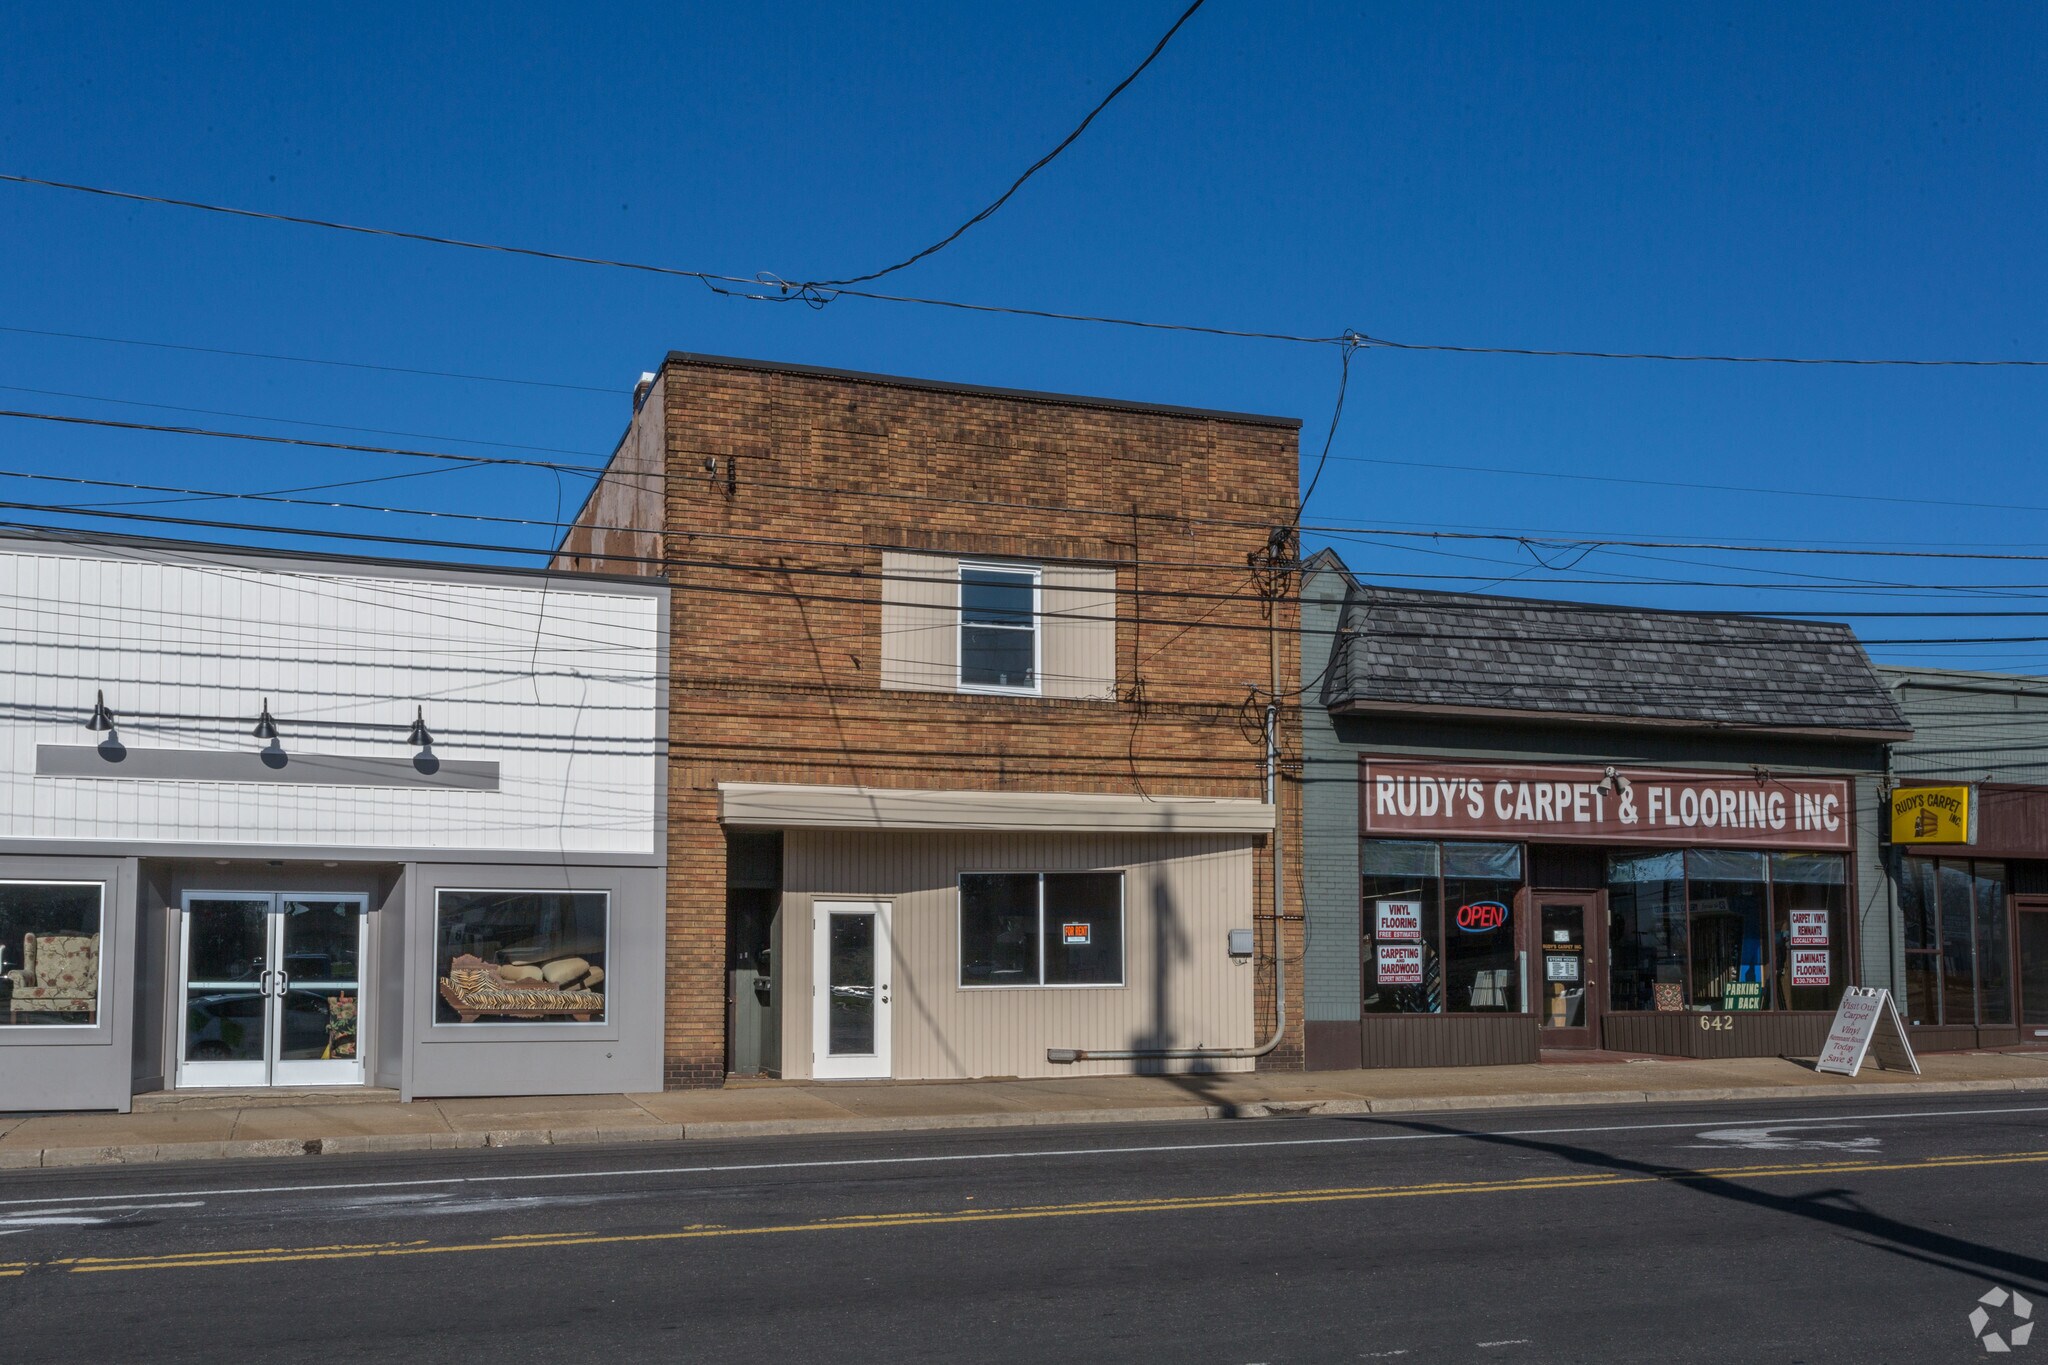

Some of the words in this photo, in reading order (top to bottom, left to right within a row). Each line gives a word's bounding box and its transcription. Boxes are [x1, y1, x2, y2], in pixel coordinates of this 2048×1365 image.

[1376, 774, 1485, 819] RUDY'S
[1494, 780, 1609, 823] CARPET
[1618, 784, 1638, 825] &
[1648, 786, 1786, 830] FLOORING
[1795, 792, 1840, 832] INC
[1895, 794, 1924, 815] RUDY'S
[1927, 794, 1961, 813] CARPET
[1389, 904, 1411, 916] VINYL
[1457, 905, 1504, 927] OPEN
[1792, 913, 1811, 924] CARPET
[1814, 913, 1827, 924] VINYL
[1381, 917, 1418, 929] FLOORING
[1065, 926, 1075, 937] FOR
[1075, 926, 1088, 937] RENT
[1798, 926, 1822, 936] REMNANTS
[1380, 948, 1419, 959] CARPETING
[1796, 953, 1826, 963] LAMINATE
[1381, 963, 1420, 974] HARDWOOD
[1796, 965, 1826, 975] FLOORING
[1726, 983, 1760, 996] PARKING
[1725, 997, 1734, 1010] IN
[1738, 997, 1760, 1009] BACK
[1842, 1001, 1860, 1010] Visit
[1860, 1002, 1876, 1011] Our
[1843, 1011, 1869, 1022] Carpet
[1700, 1015, 1734, 1031] 642
[1841, 1026, 1861, 1035] Vinyl
[1833, 1042, 1856, 1052] Today
[1827, 1054, 1845, 1063] Save
